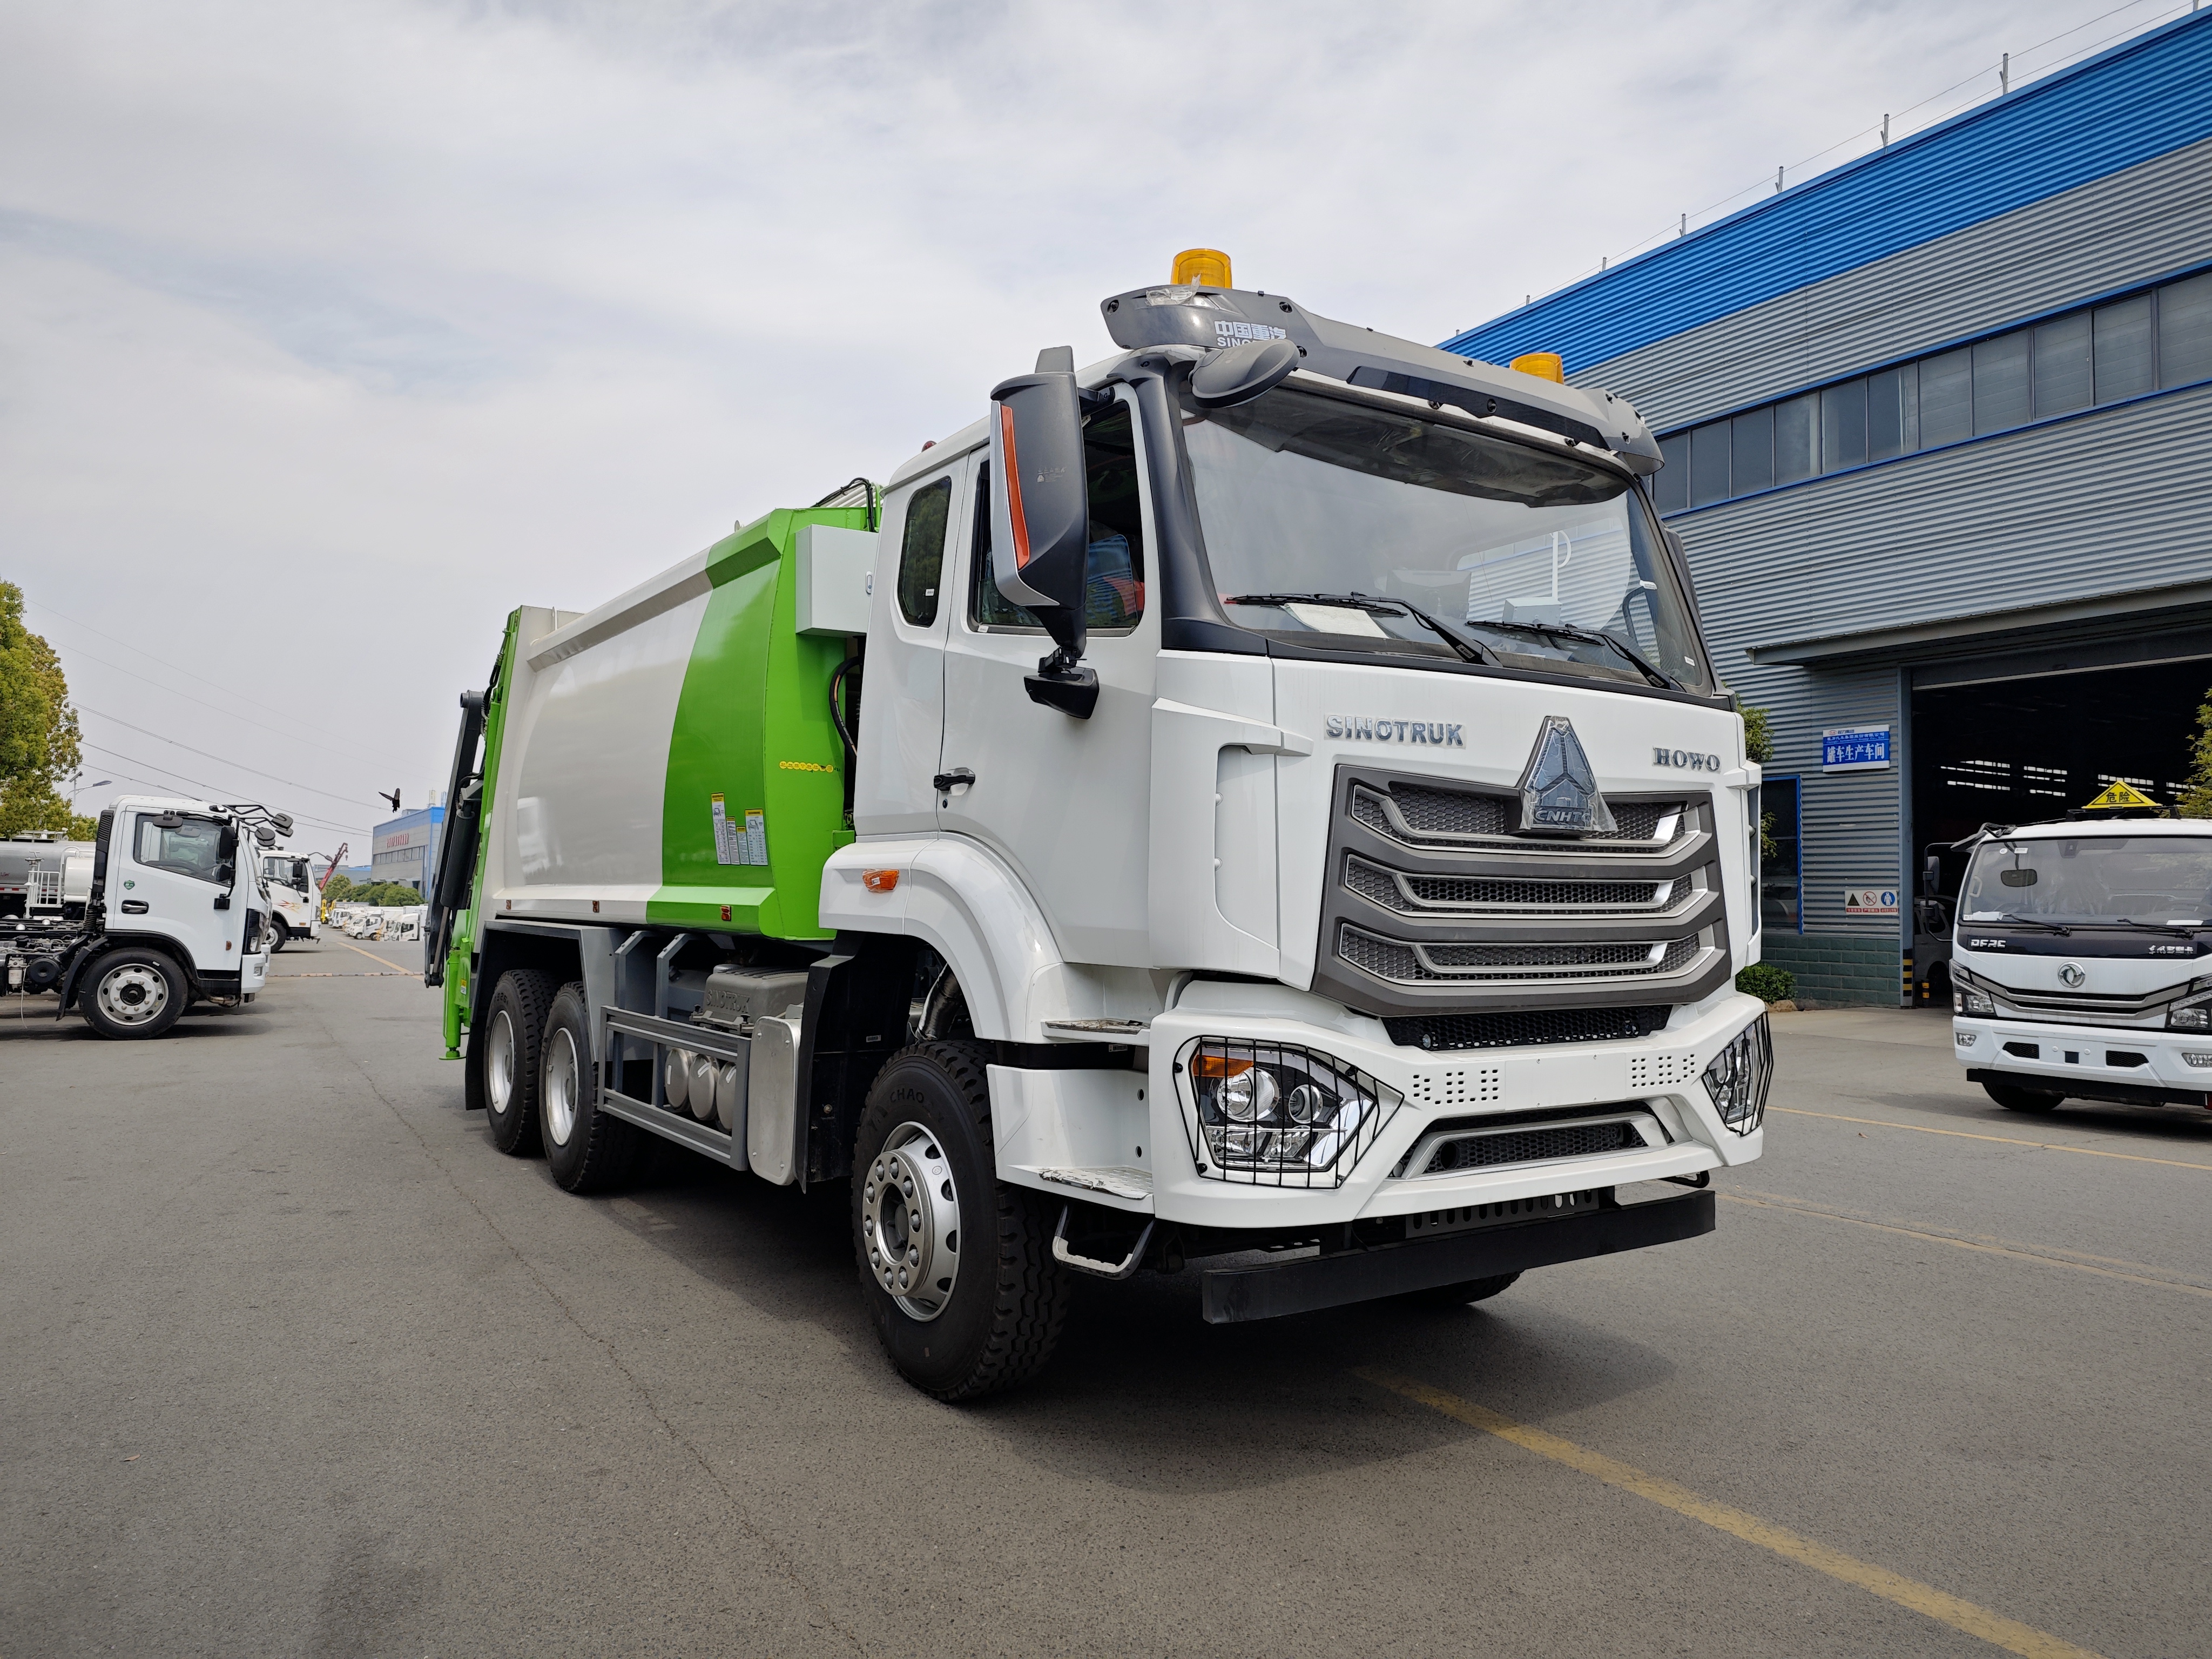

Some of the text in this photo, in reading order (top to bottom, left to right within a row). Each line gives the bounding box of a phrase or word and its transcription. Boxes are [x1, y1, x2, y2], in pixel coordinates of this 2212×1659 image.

[1326, 715, 1464, 746] SINOTRUK
[1653, 747, 1721, 772] HOWO
[1826, 742, 1885, 763] 罐车生产车间
[2106, 791, 2130, 803] 危险
[706, 989, 750, 1014] SINOTRUK
